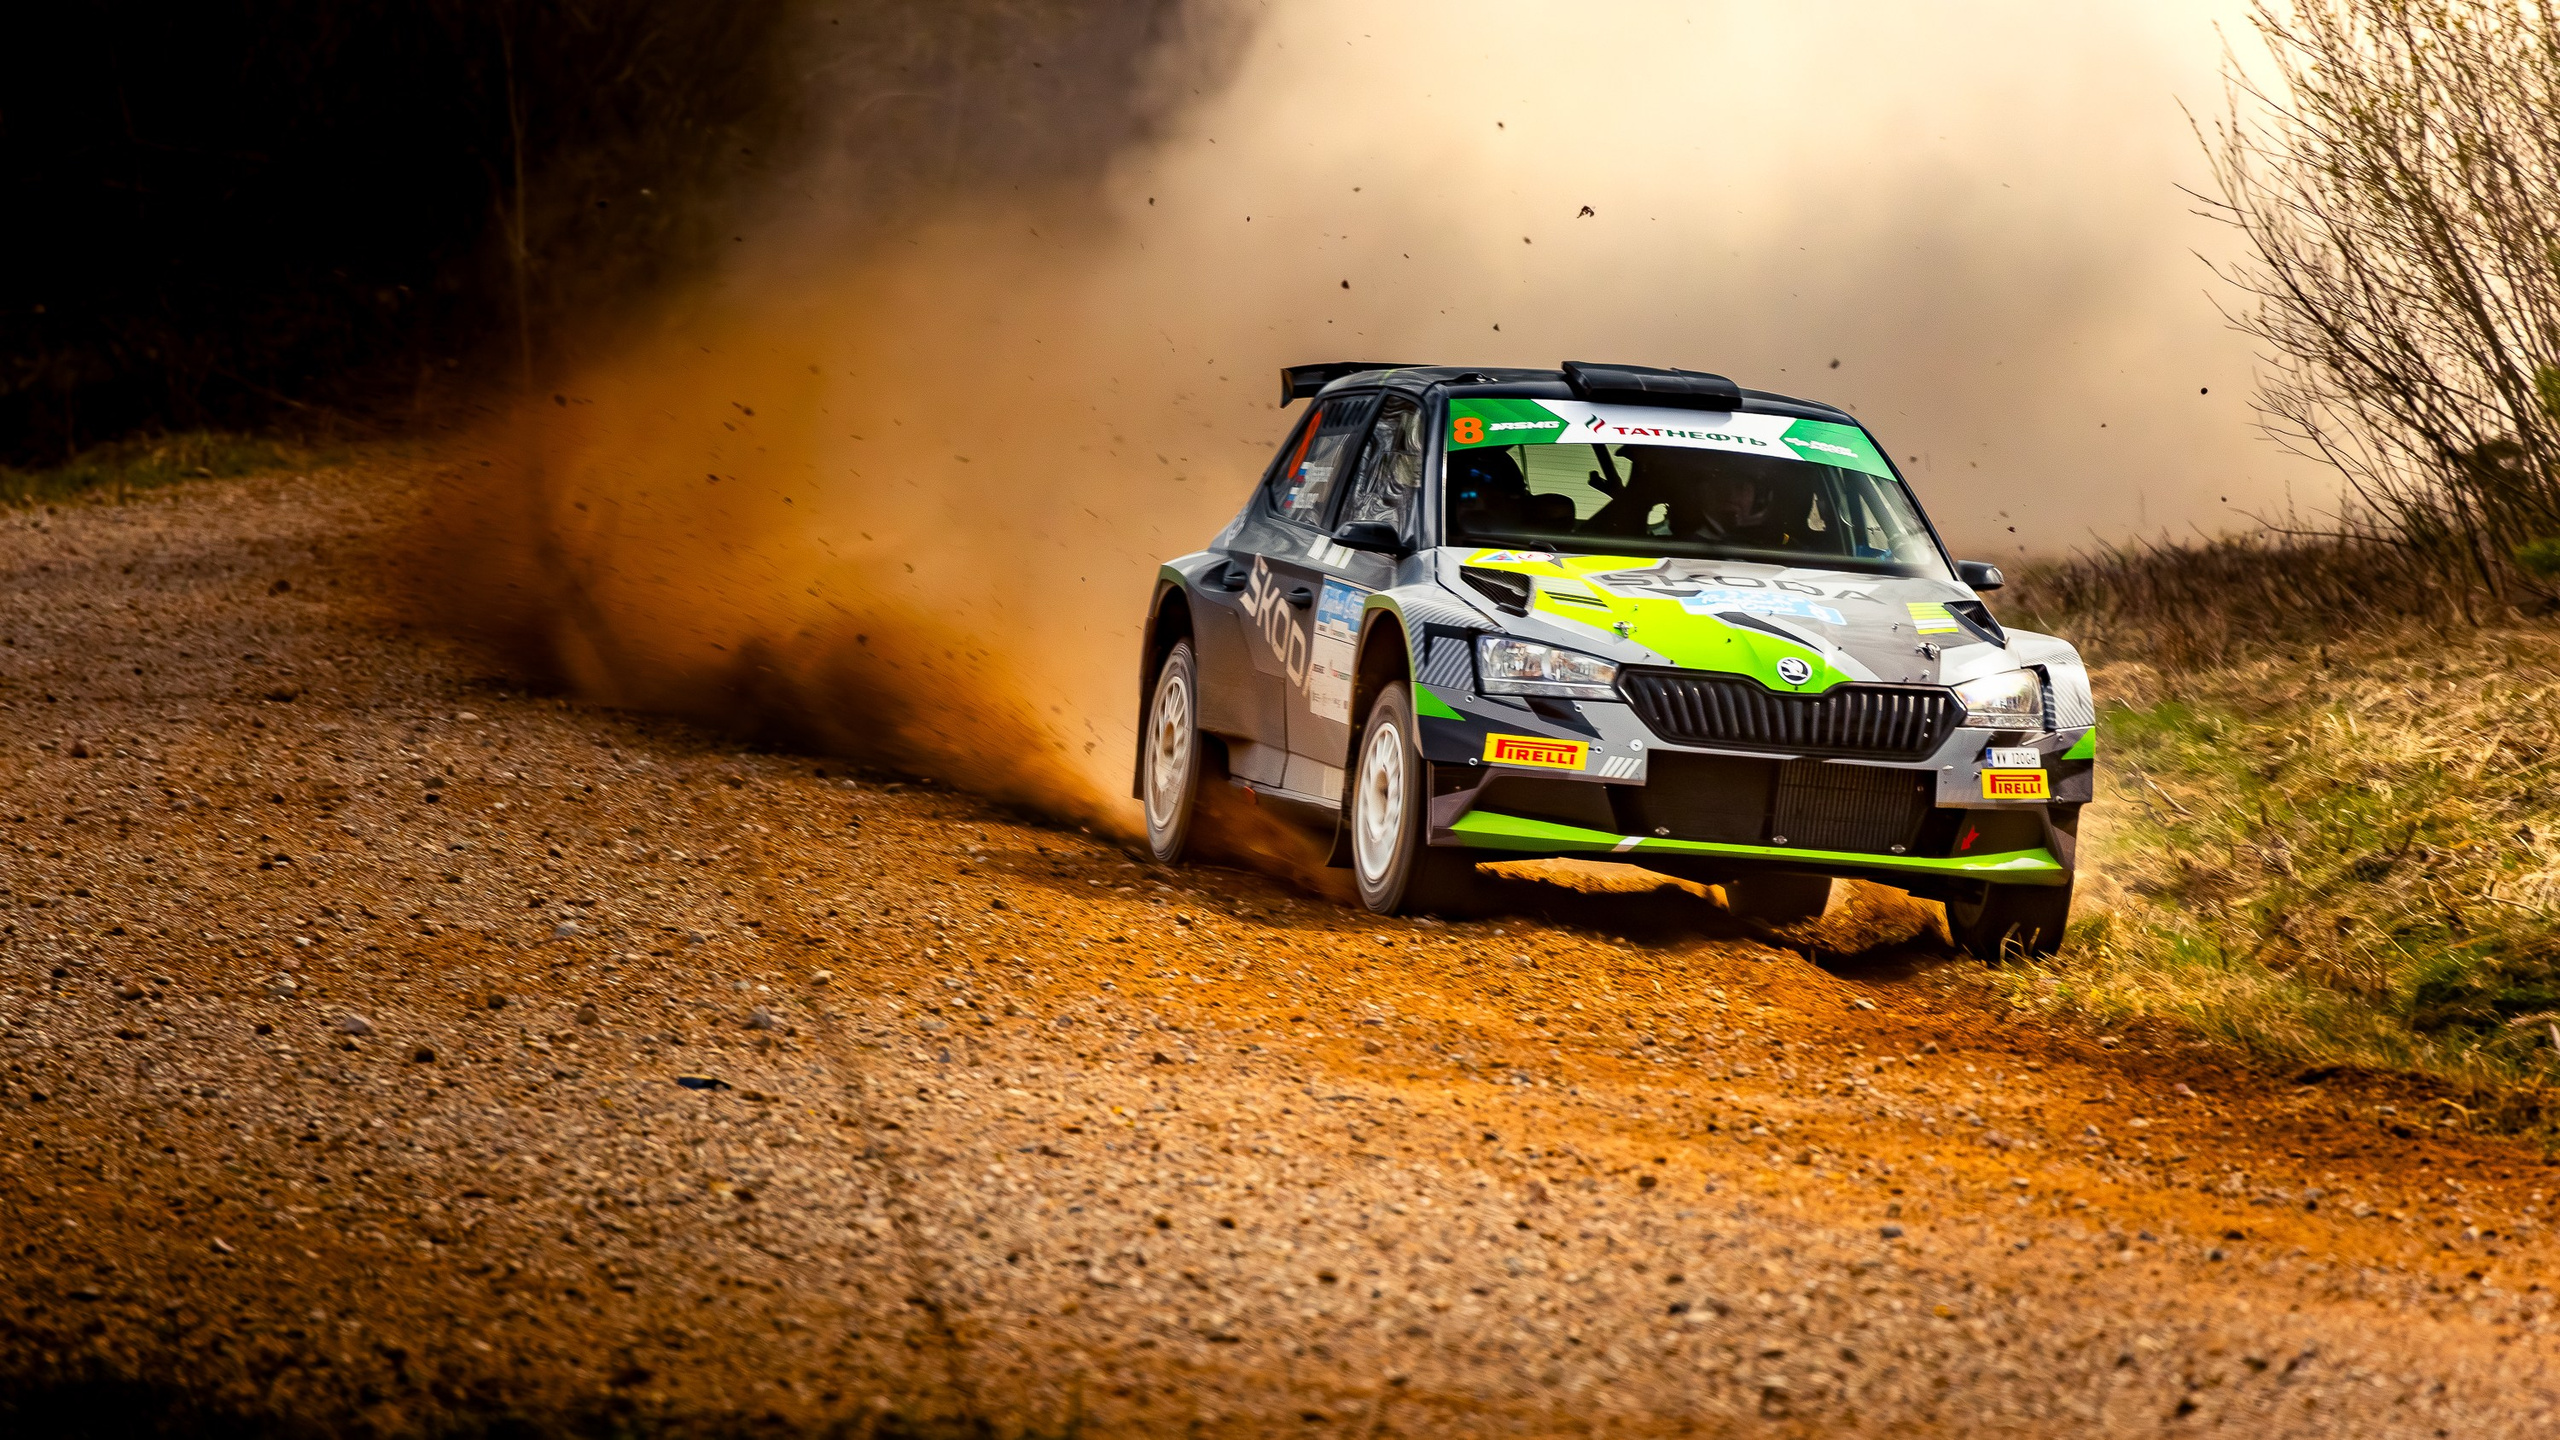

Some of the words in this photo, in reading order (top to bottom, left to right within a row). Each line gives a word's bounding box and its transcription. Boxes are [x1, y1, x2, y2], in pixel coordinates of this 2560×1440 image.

[1453, 417, 1484, 444] 8
[1613, 427, 1767, 447] ТАТНЕФТЬ
[1239, 552, 1310, 697] SKOD
[1495, 739, 1578, 765] PIRELLI
[1990, 774, 2041, 794] PIRELLI
